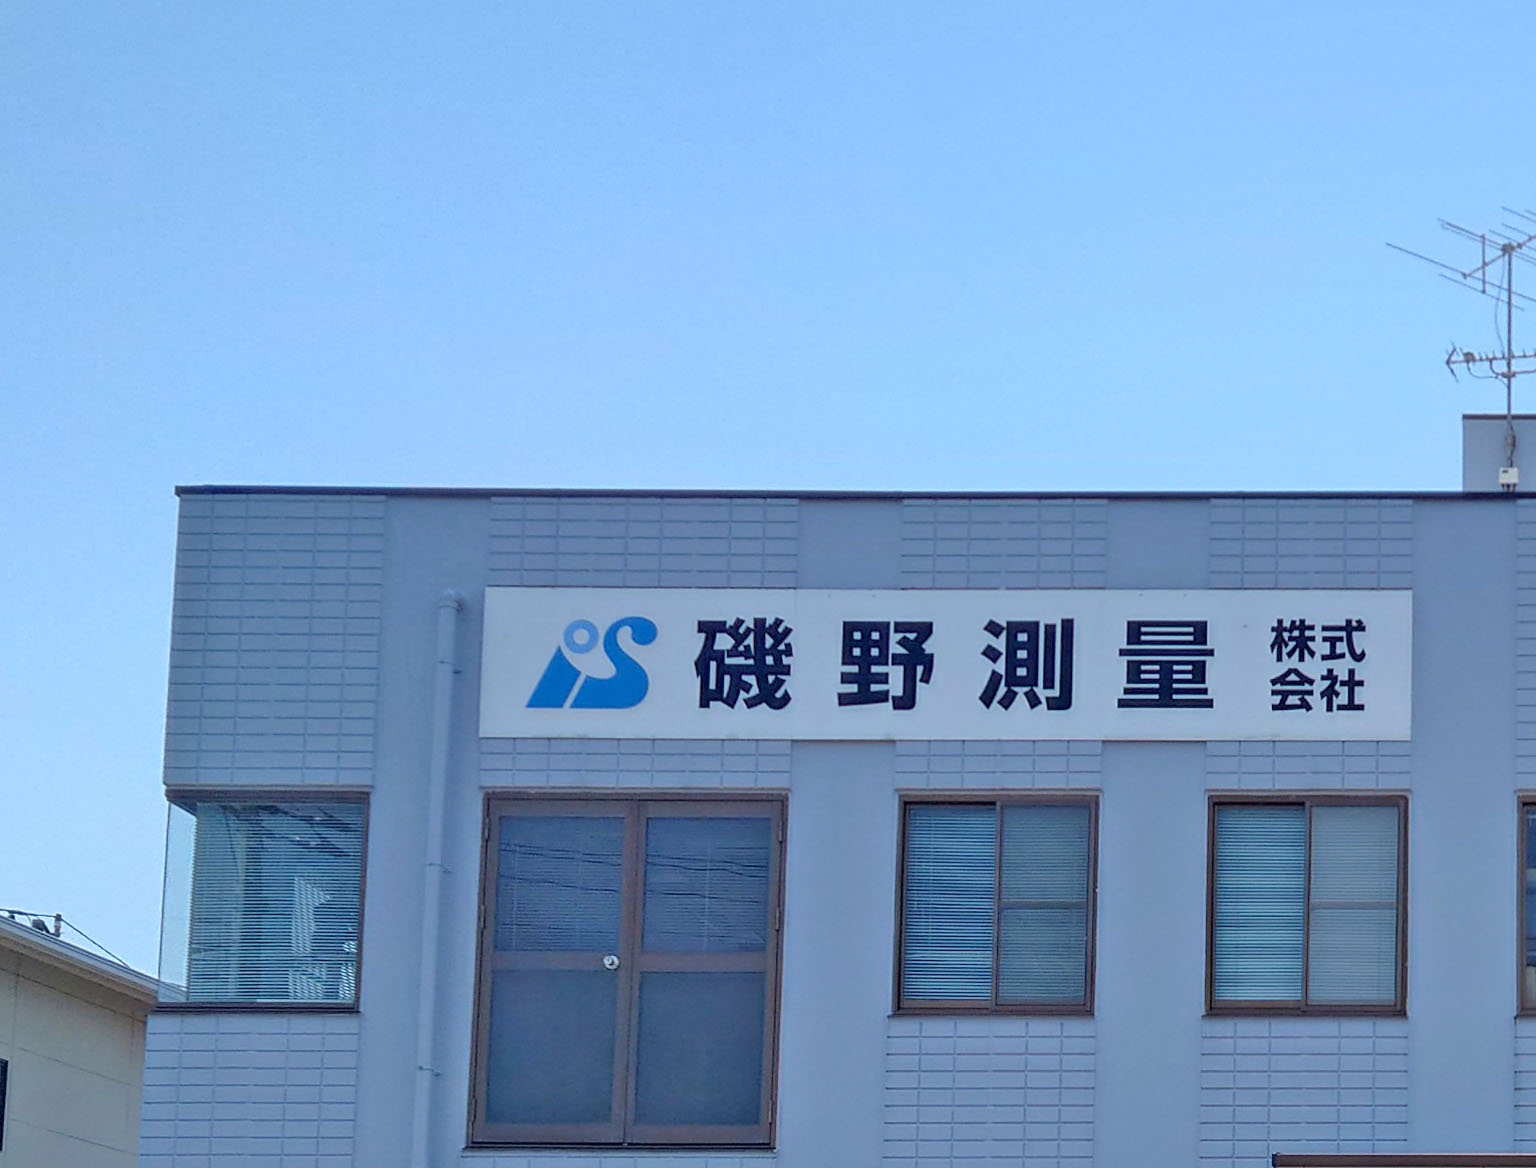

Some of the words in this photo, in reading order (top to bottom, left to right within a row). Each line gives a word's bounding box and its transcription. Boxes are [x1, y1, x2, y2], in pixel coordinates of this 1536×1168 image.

[1271, 620, 1366, 663] 株式
[696, 619, 1215, 711] 磯野測量
[1271, 669, 1365, 713] 会社
